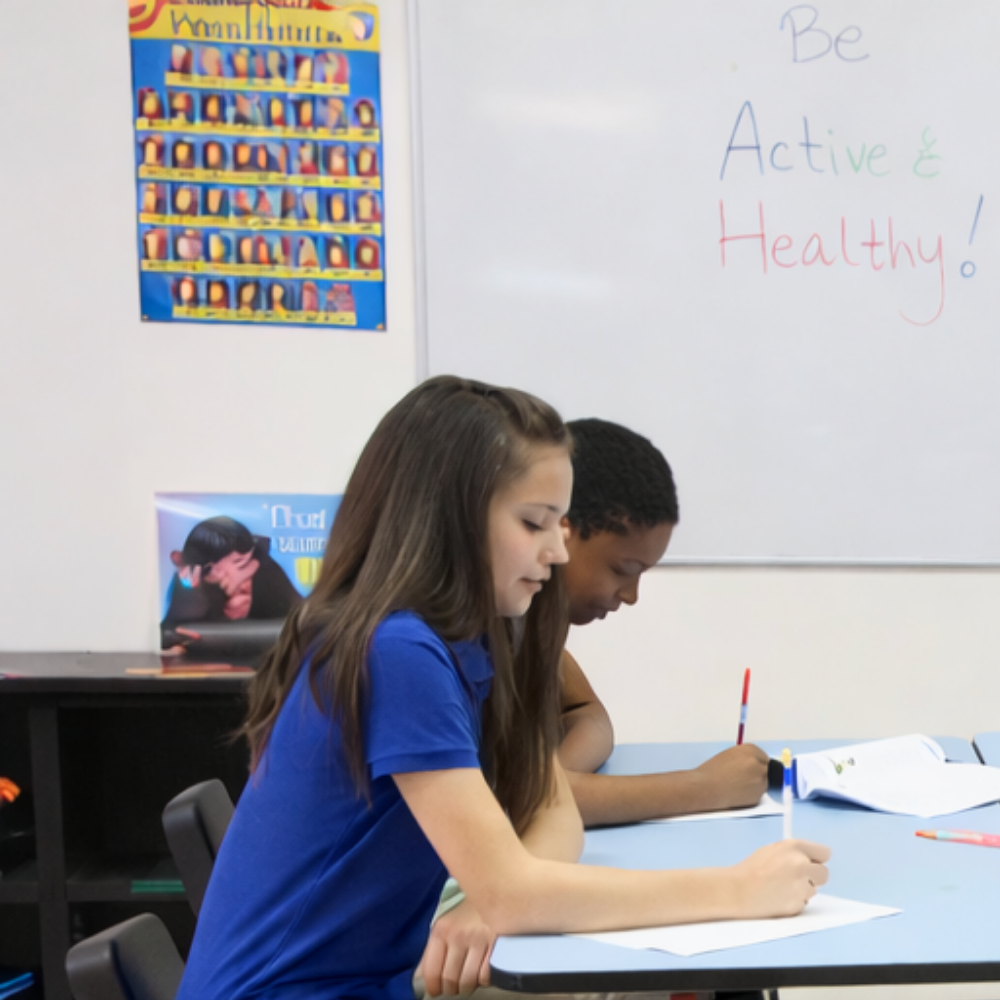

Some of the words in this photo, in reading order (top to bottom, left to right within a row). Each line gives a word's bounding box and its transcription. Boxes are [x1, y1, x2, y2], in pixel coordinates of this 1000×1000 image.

[779, 4, 870, 63] Be
[720, 100, 891, 181] Active
[719, 194, 984, 326] Healthy!
